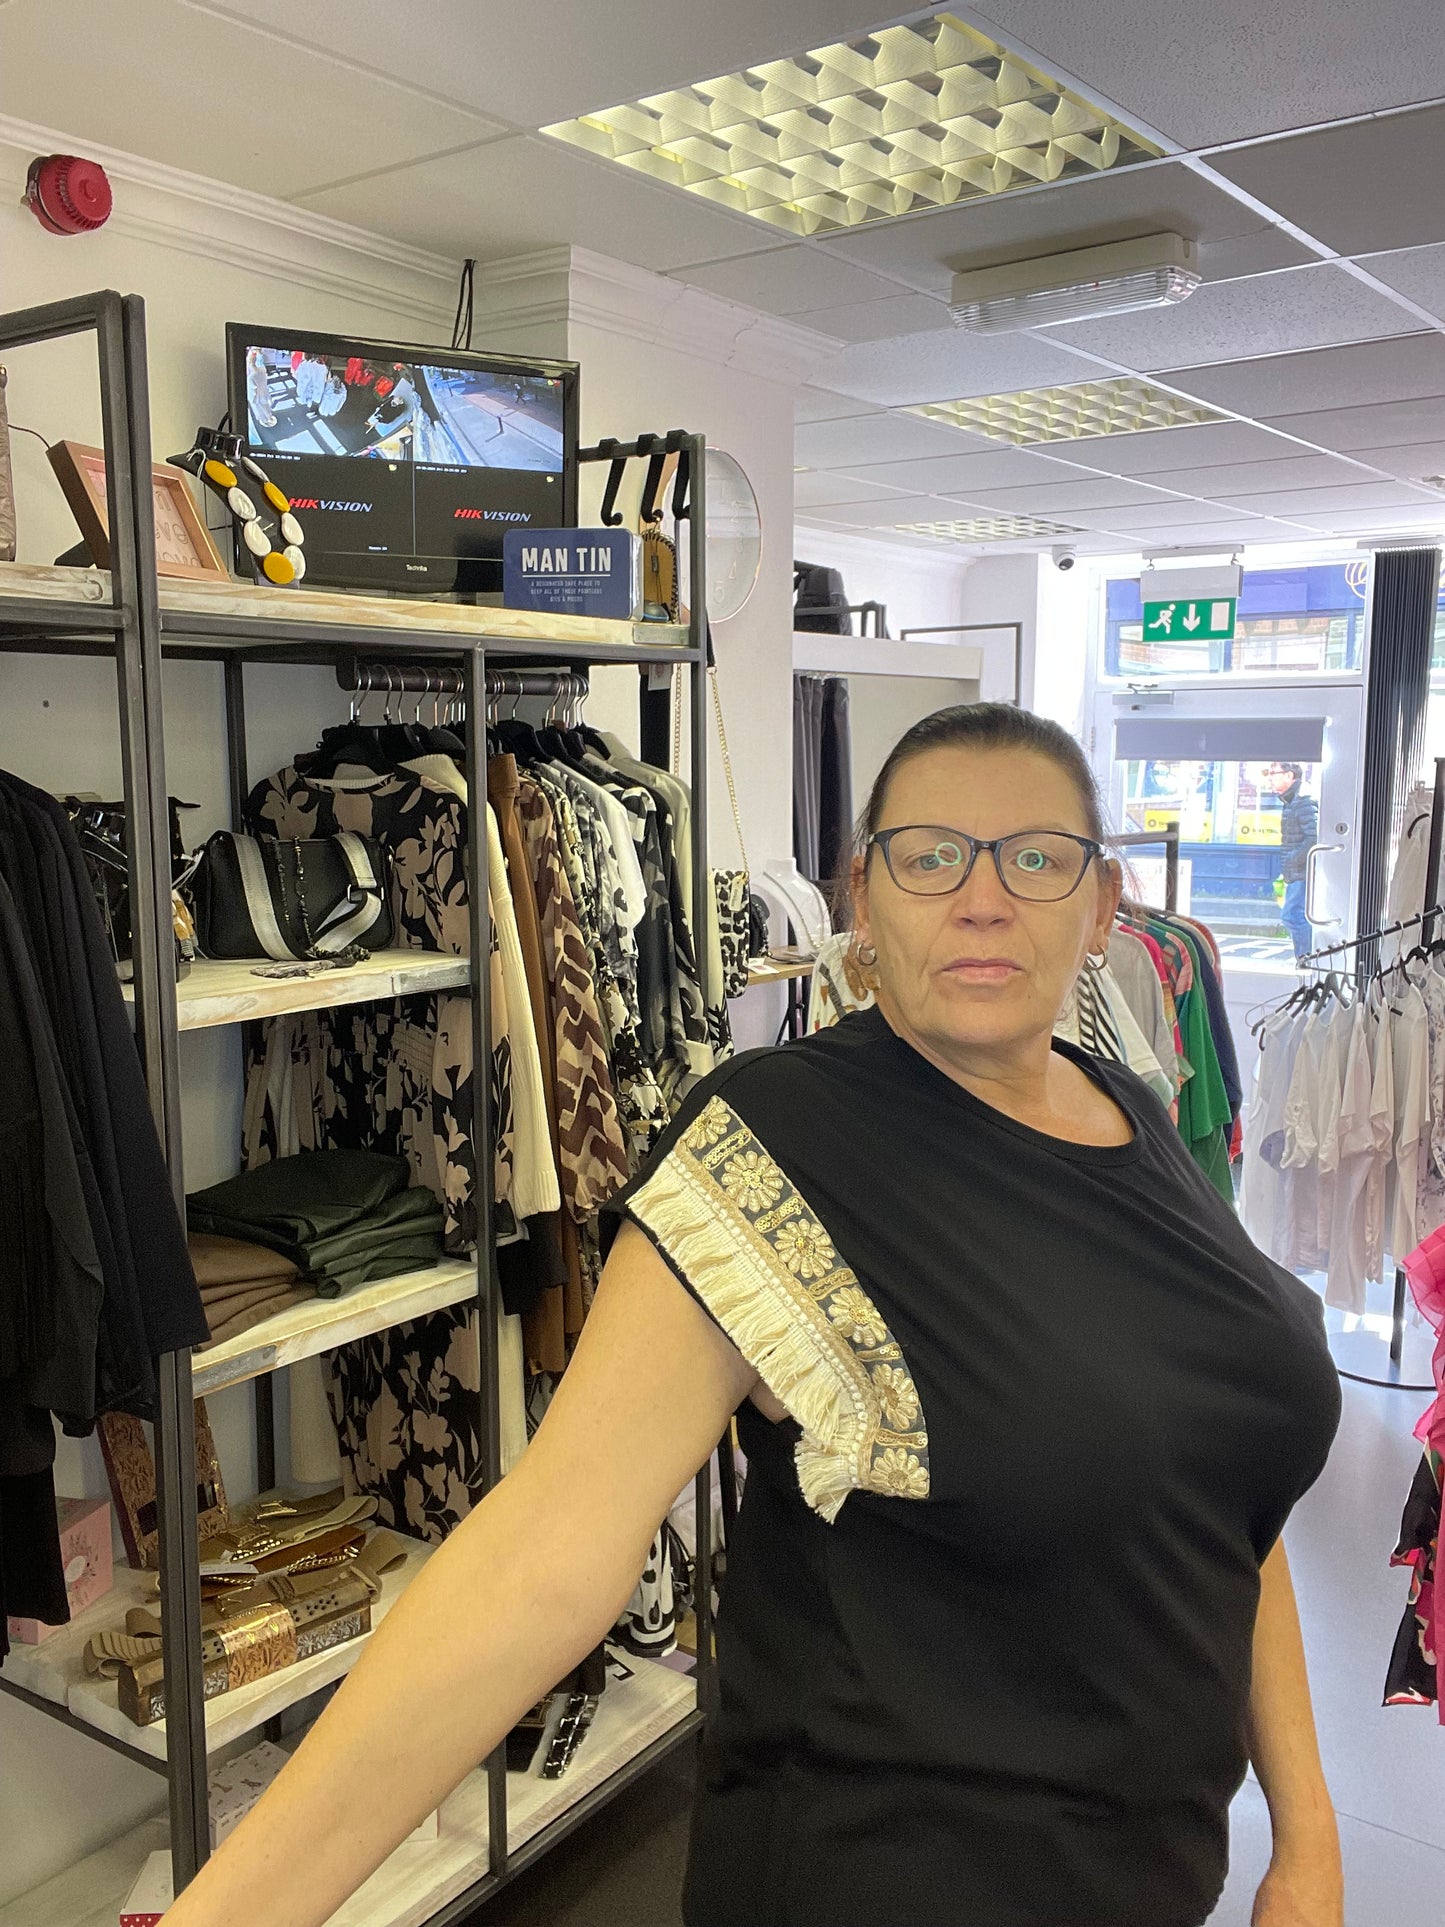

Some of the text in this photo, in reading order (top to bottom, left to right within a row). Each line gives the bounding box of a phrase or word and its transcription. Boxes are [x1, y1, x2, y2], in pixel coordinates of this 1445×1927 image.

[288, 498, 373, 513] HIKVISION
[453, 508, 532, 523] HIKVISION
[522, 547, 611, 573] MAN TIN
